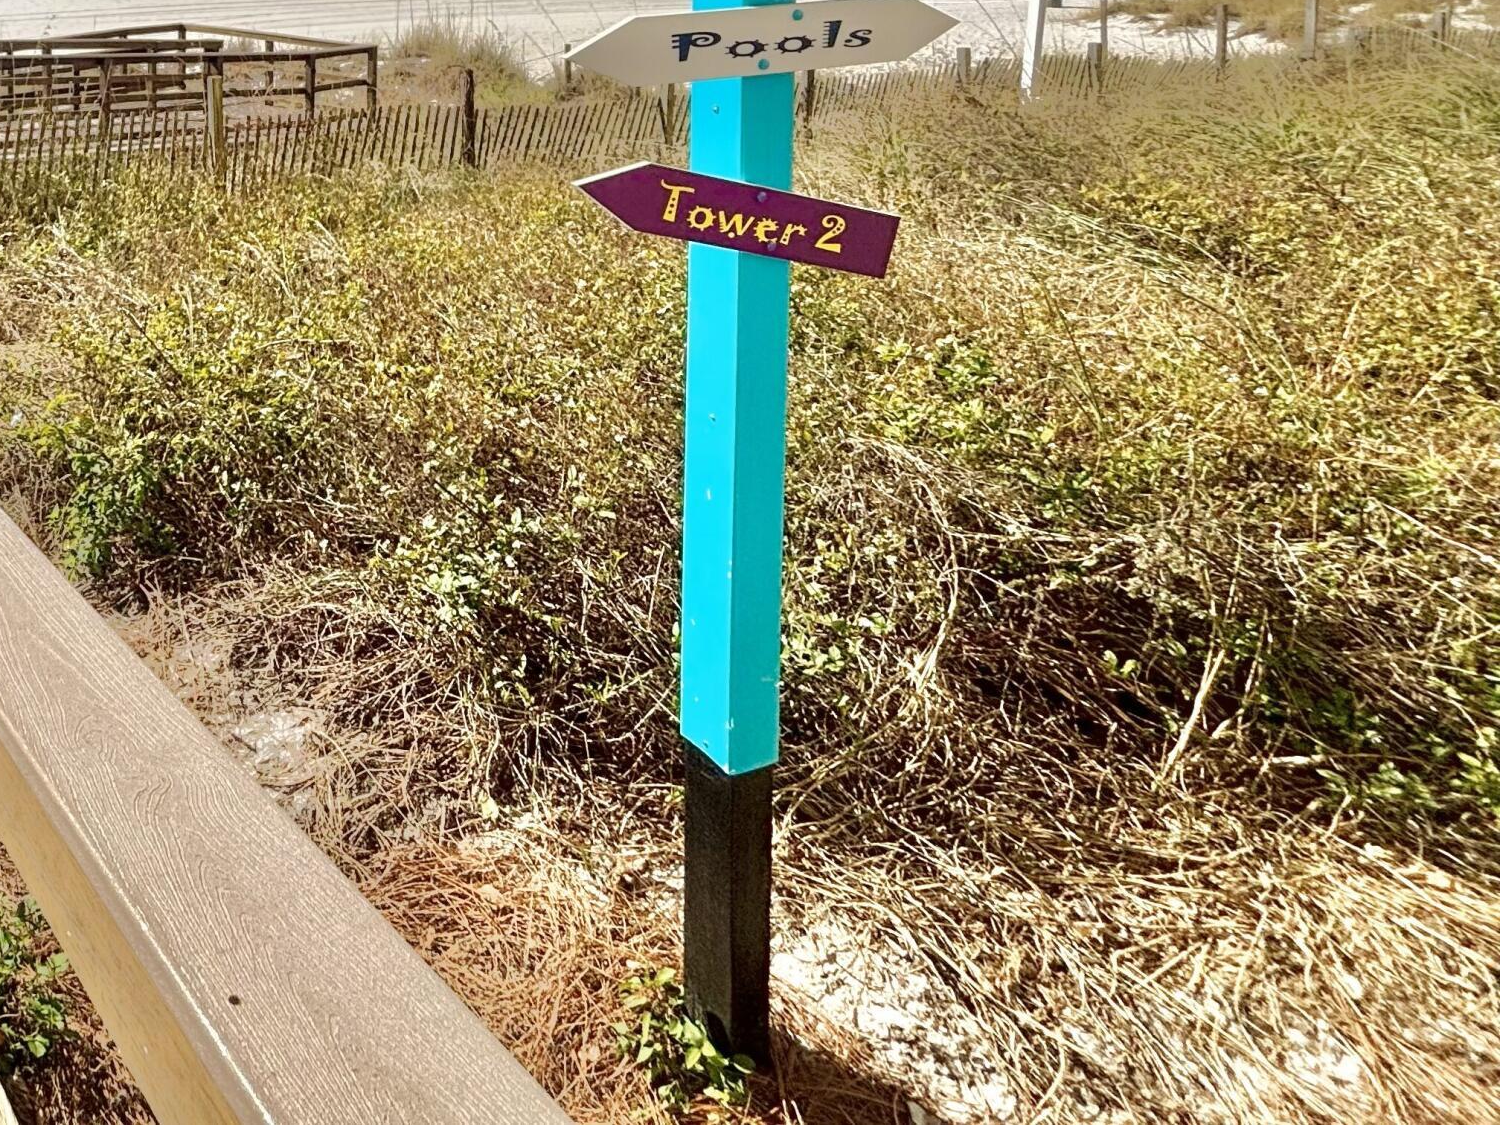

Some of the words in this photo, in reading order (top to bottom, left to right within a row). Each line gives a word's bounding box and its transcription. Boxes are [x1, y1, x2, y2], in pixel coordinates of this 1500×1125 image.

[670, 19, 873, 62] Pools
[660, 178, 808, 247] Tower
[814, 213, 847, 254] 2
